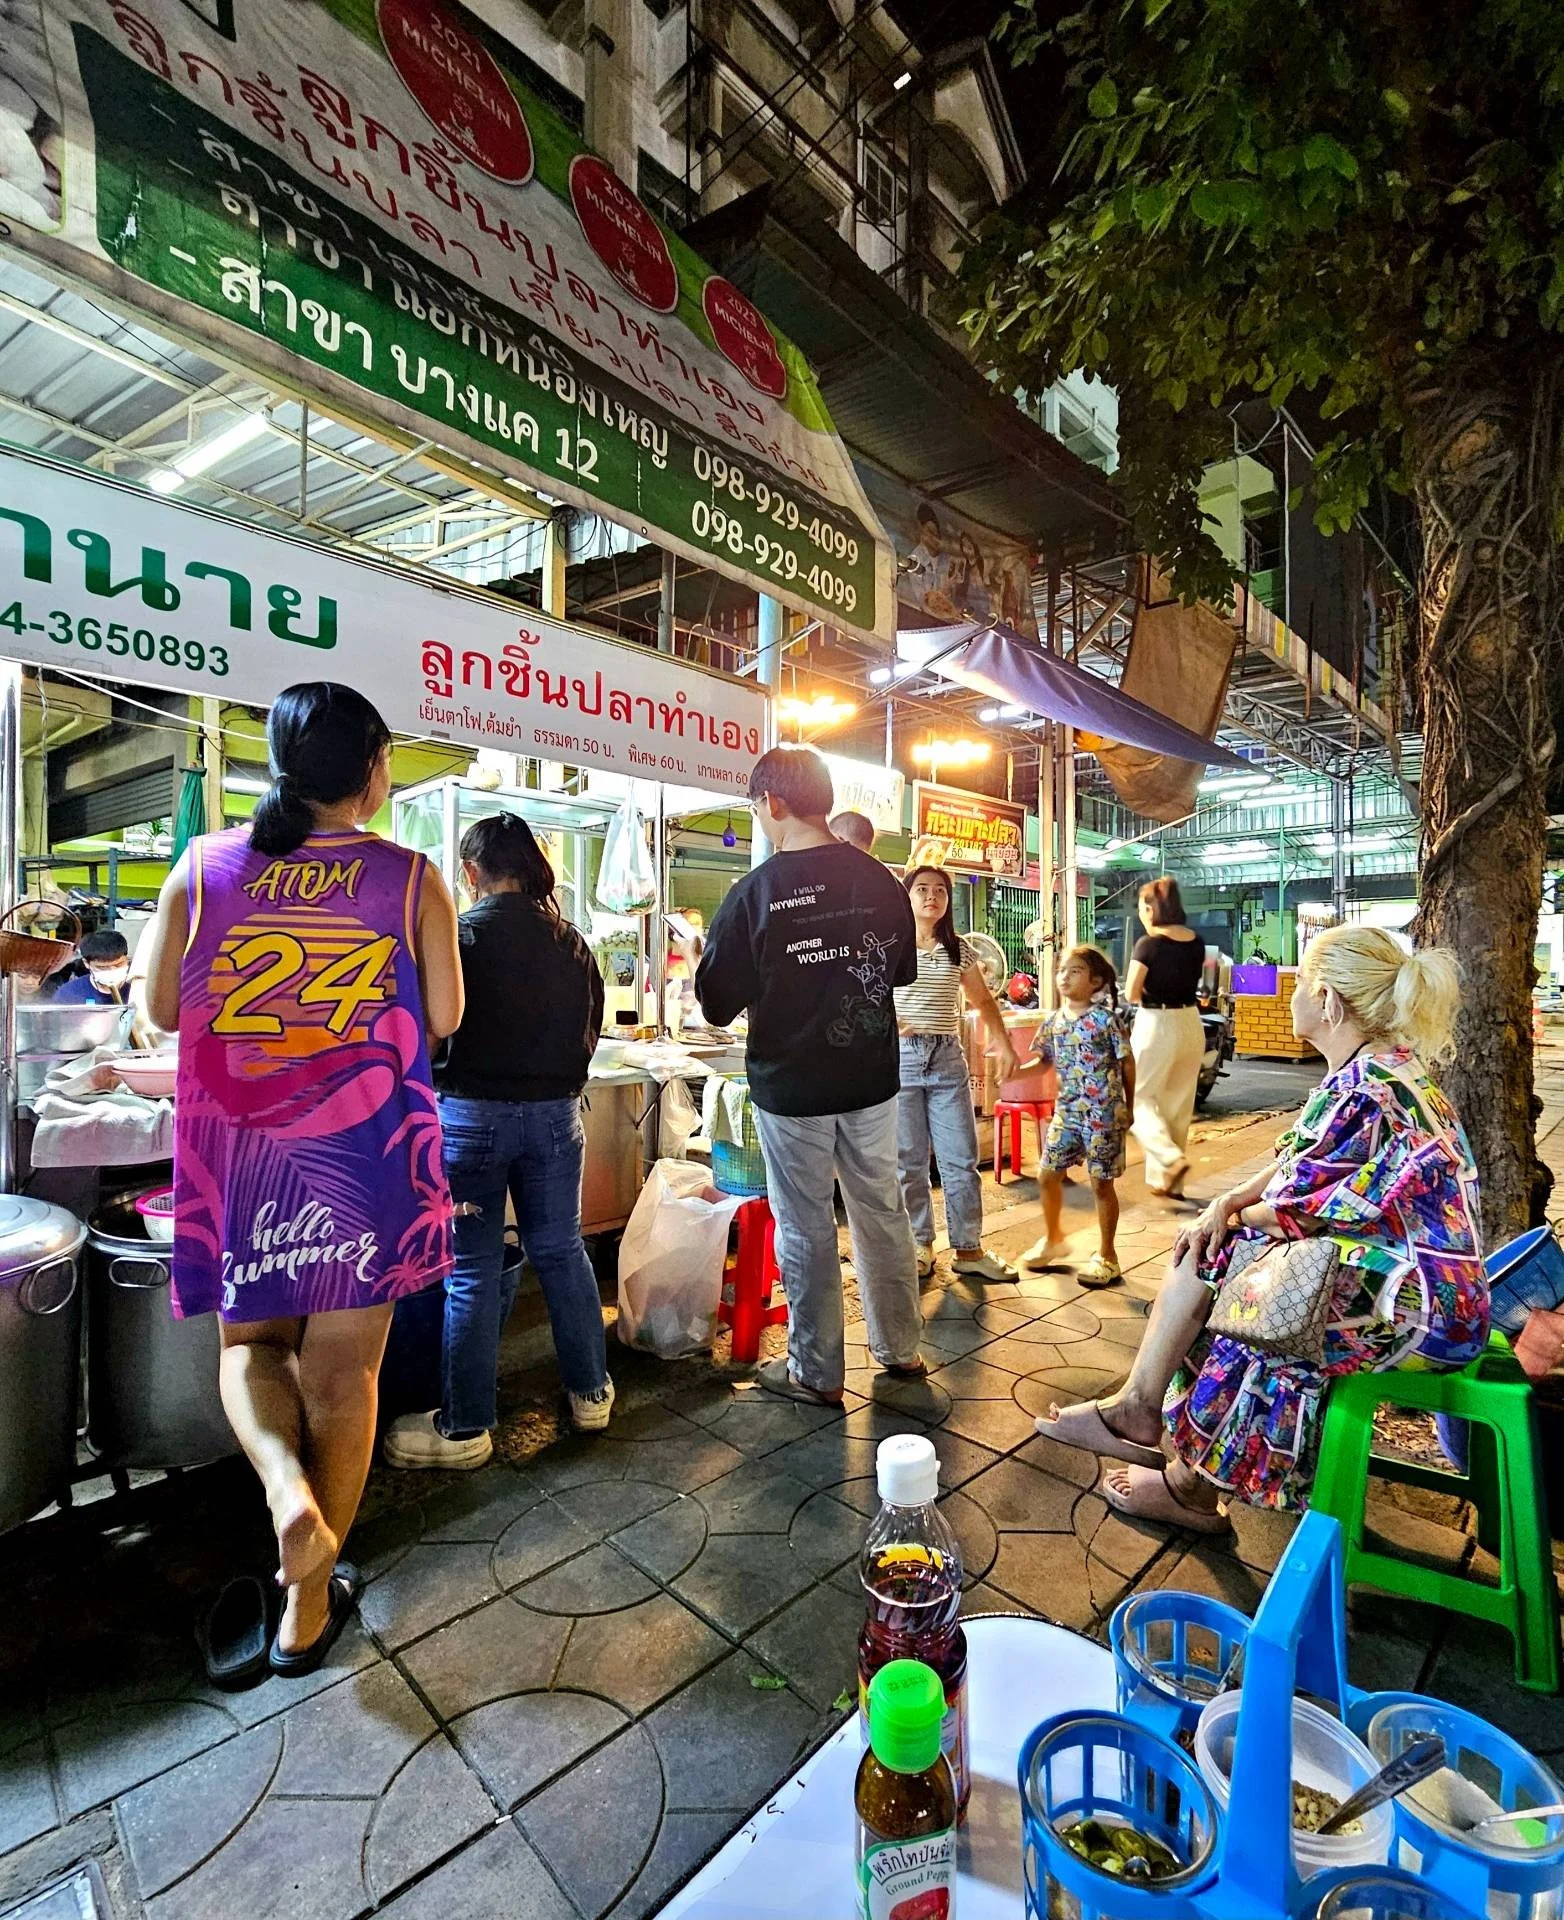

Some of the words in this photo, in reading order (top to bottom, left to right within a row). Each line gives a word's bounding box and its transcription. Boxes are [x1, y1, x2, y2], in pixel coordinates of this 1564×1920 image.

[430, 12, 481, 73] 2021
[401, 17, 511, 129] MICHELIN
[585, 185, 662, 264] MICHELIN
[603, 178, 642, 223] 2022
[214, 179, 374, 292] สาขา
[296, 63, 766, 426] ลูกชิ้นปลาทำเอง
[714, 302, 774, 360] MICHELIN
[727, 295, 757, 328] 2023
[218, 255, 373, 372] สาขา
[390, 343, 540, 455] บางแค
[555, 427, 601, 484] 12
[693, 445, 859, 567] 098-929-4099
[691, 498, 857, 613] 098-929-4099
[420, 628, 760, 756] ลูกชิ้นปลาทำเอง
[418, 697, 523, 740] เย็นตาโฟ,ต้มยำ
[533, 727, 580, 752] ธรรมดา
[628, 743, 657, 767] พิเศษ
[697, 761, 734, 785] เกาเหลา
[926, 811, 1018, 845] กระเพาะปลา
[243, 858, 366, 903] ATOM
[769, 895, 817, 912] ANYWHERE
[798, 885, 815, 895] WILL
[786, 938, 823, 953] ANOTHER
[797, 948, 838, 965] WORLD
[839, 945, 850, 957] IS
[209, 931, 398, 1041] 24
[246, 1200, 335, 1253] hello
[886, 1872, 924, 1896] Ground
